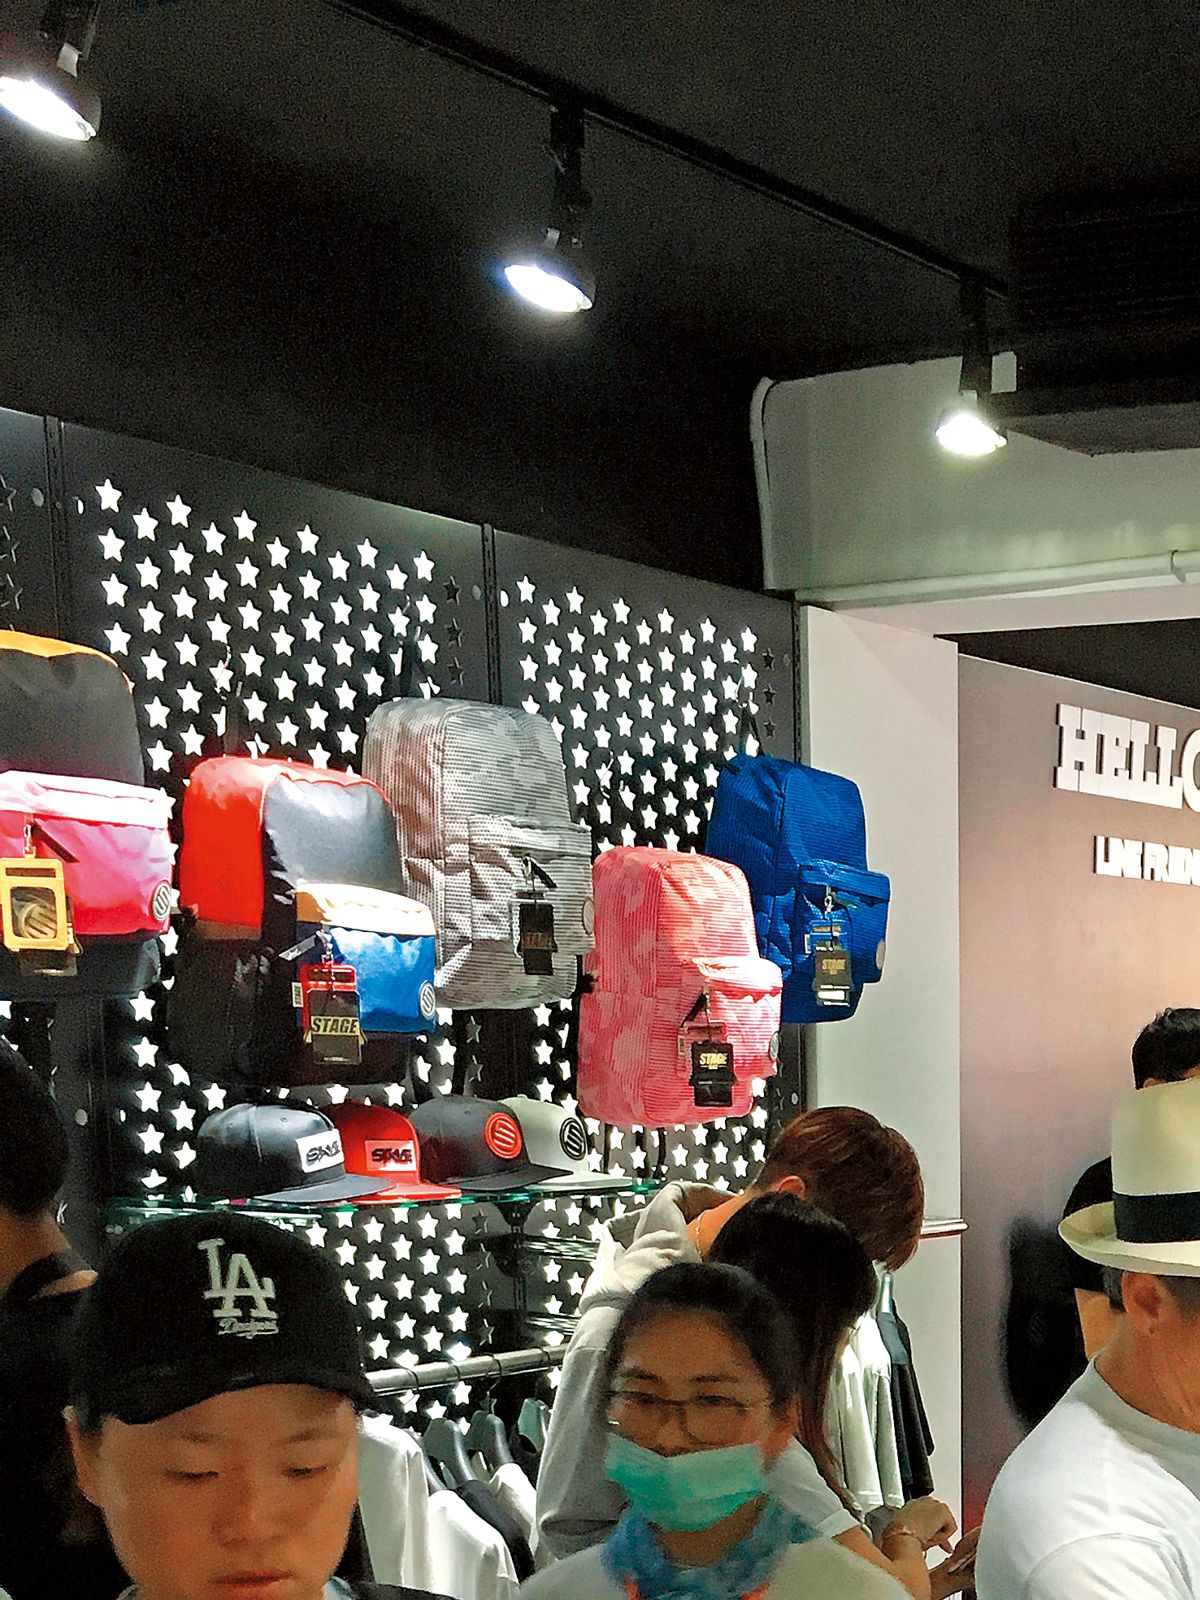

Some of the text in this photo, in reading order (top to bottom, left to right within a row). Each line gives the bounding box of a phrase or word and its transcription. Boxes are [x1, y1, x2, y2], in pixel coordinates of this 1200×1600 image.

[1094, 835, 1143, 880] LINE
[312, 1017, 359, 1033] STAGE
[700, 1052, 728, 1066] STAGE
[198, 1238, 278, 1318] LA
